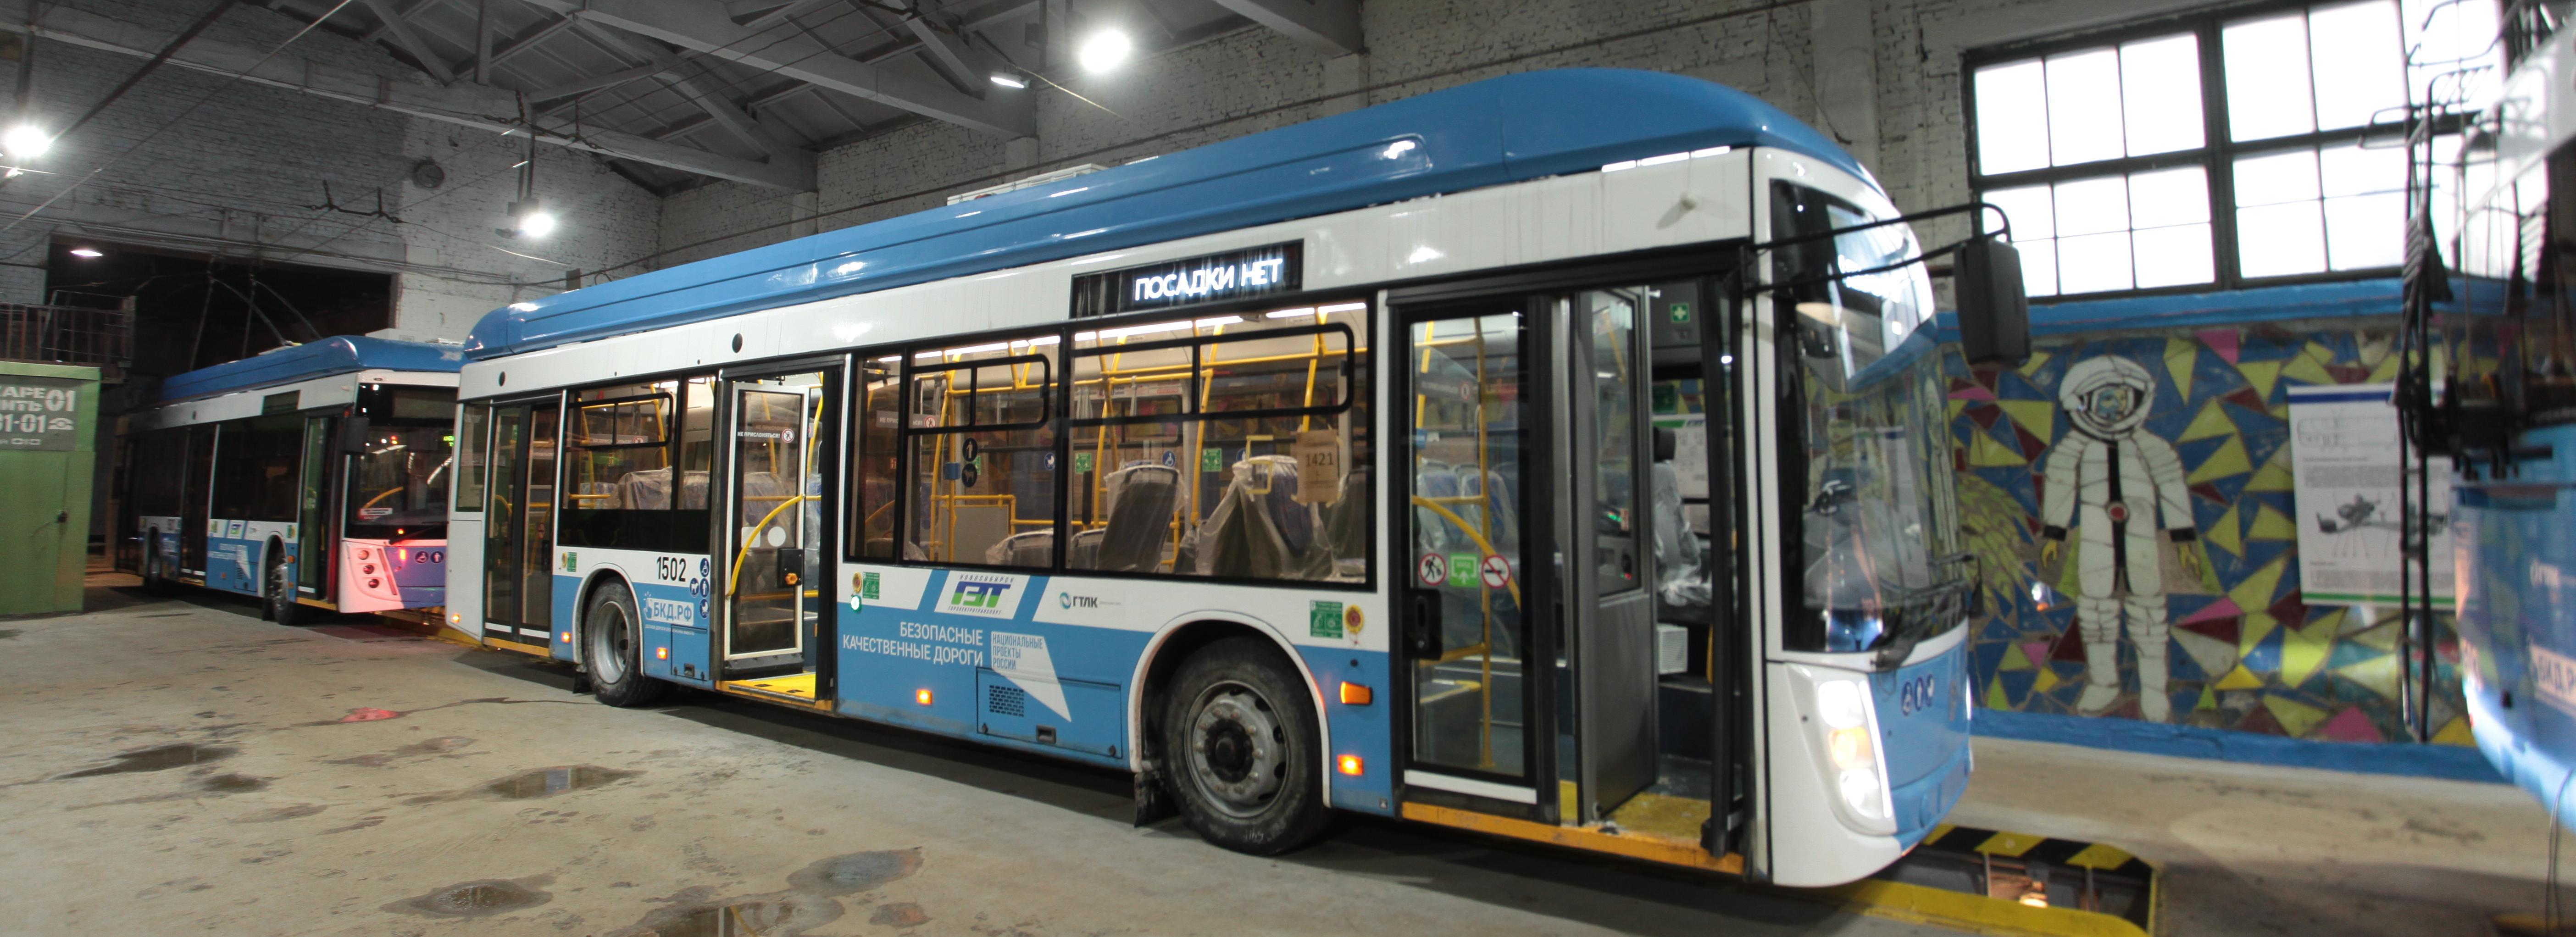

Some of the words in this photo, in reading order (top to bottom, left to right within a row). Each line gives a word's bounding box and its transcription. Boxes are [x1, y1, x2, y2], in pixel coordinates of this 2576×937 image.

[1135, 265, 1234, 301] ПОСАДКИ
[1240, 258, 1283, 286] НЕТ
[45, 389, 76, 411] 01
[1306, 453, 1333, 467] 1421
[656, 556, 686, 582] 1502
[959, 574, 1014, 583] НОВОСИБИРСК
[948, 605, 1002, 615] ГОРЭЛЕКТРОТРАНСПОРТ
[1072, 596, 1098, 608] ГТЛК
[653, 601, 692, 622] БКД.РФ
[899, 621, 983, 646] БЕЗОПАСНЫЕ
[992, 633, 1044, 650] НАЦИОНАЛЬНЫЕ
[843, 634, 931, 660] КАЧЕСТВЕННЫЕ
[933, 645, 984, 667] ДОРОГИ
[992, 645, 1021, 659] ПРОЕКТЫ
[993, 657, 1016, 670] РОССИИ
